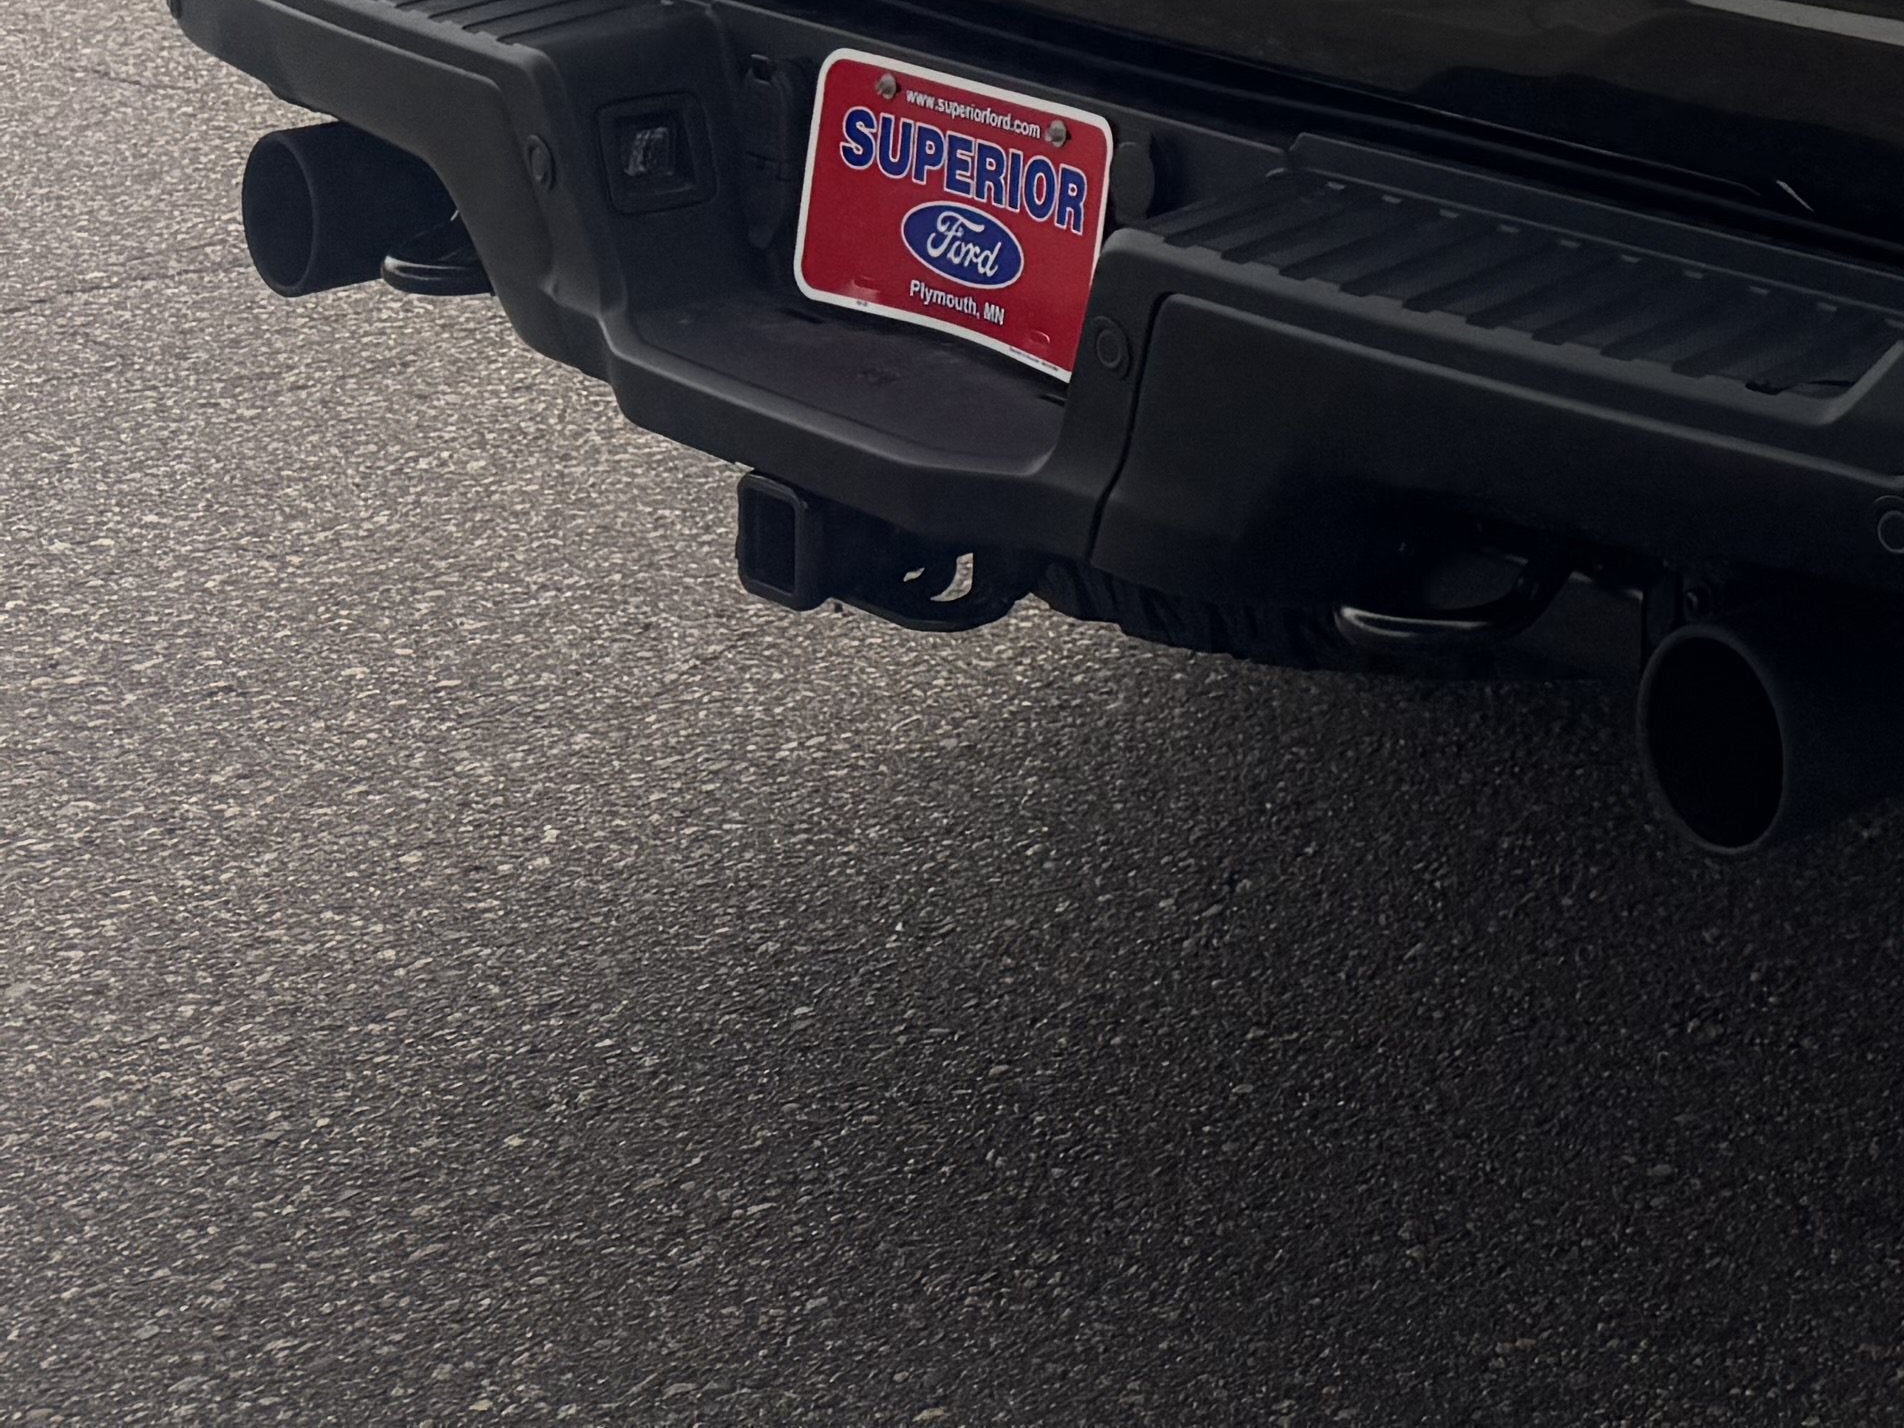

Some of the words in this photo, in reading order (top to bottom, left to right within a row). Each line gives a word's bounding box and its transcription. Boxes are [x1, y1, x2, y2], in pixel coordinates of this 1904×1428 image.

[906, 89, 1041, 139] www.superiorford.com
[840, 106, 1088, 235] SUPERIOR
[927, 210, 1002, 278] Ford
[910, 280, 980, 320] Plymouth,
[984, 302, 1005, 325] MN
